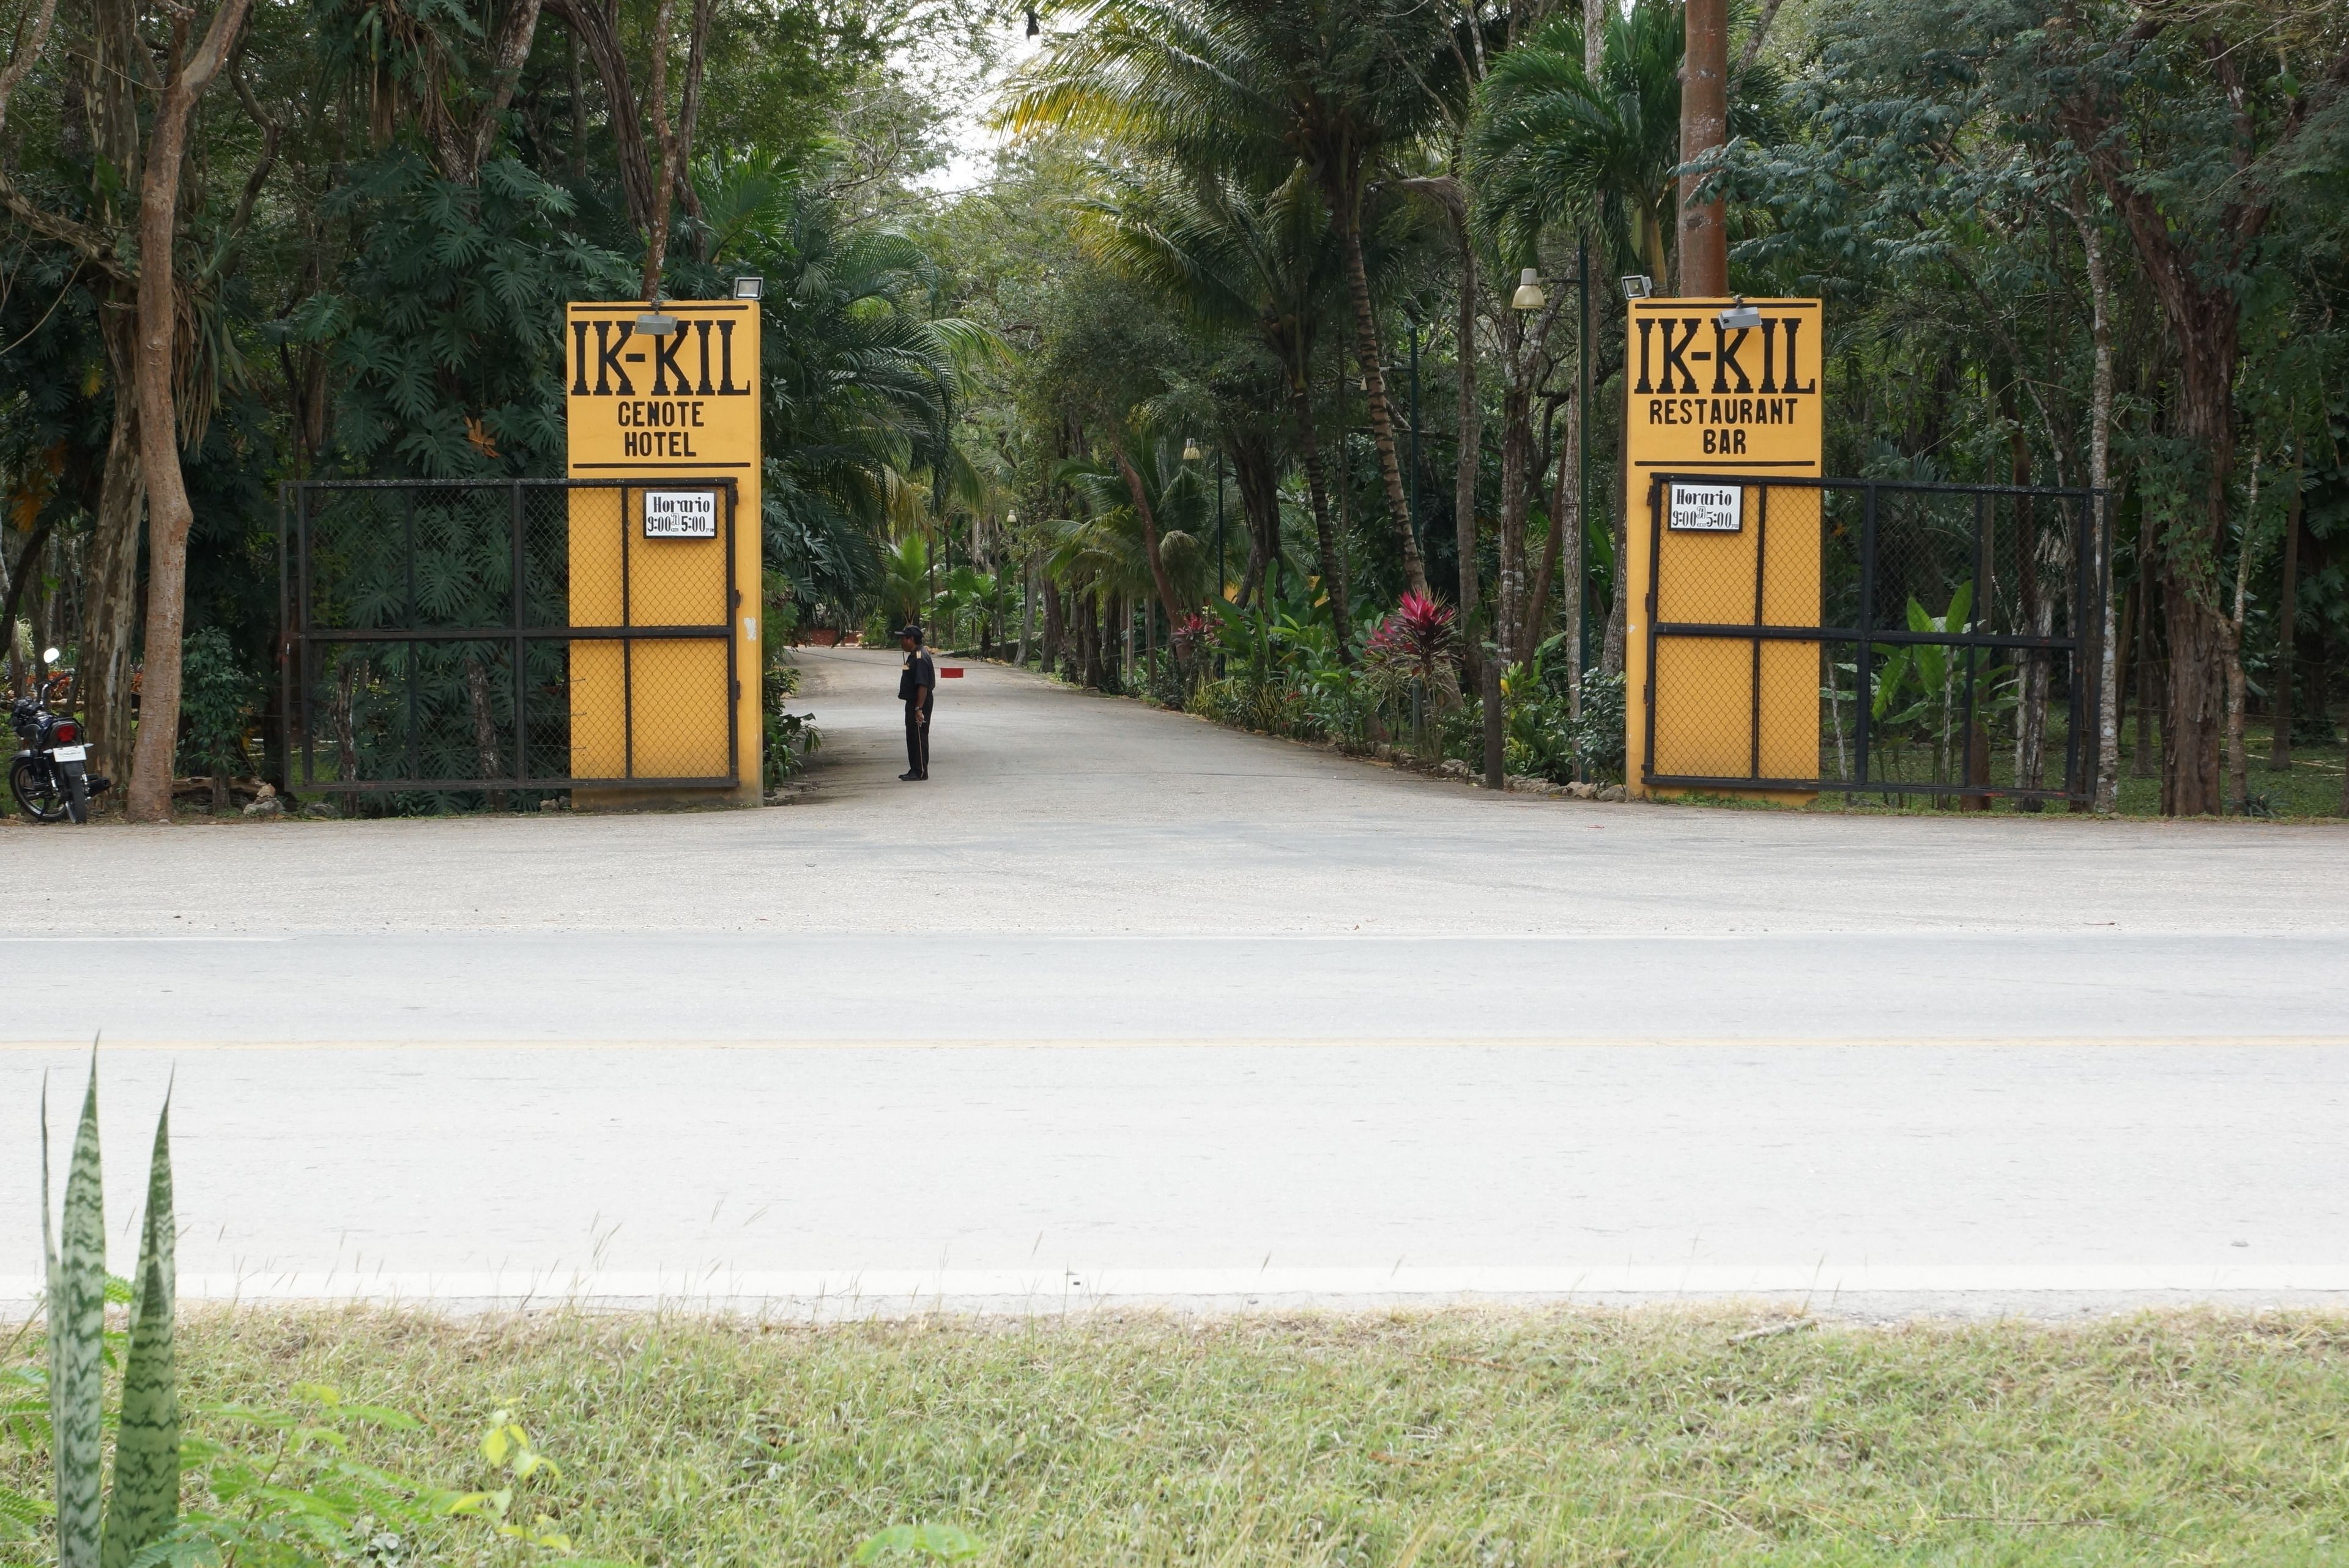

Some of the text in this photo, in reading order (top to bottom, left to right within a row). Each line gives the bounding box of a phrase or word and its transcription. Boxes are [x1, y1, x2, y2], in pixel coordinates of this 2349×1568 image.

[571, 320, 751, 395] IK-KIL
[1634, 318, 1816, 394] IK-KIL
[618, 401, 704, 427] CENOTE
[1650, 398, 1798, 424] RESTAURANT
[625, 432, 697, 457] HOTEL
[1703, 429, 1746, 454] BAR
[653, 496, 710, 513] Horario
[1676, 489, 1732, 506] Horario
[648, 516, 671, 532] 9:00
[681, 516, 705, 532] 5:00
[1672, 510, 1696, 527] 9:00
[1706, 511, 1732, 528] 5:00
